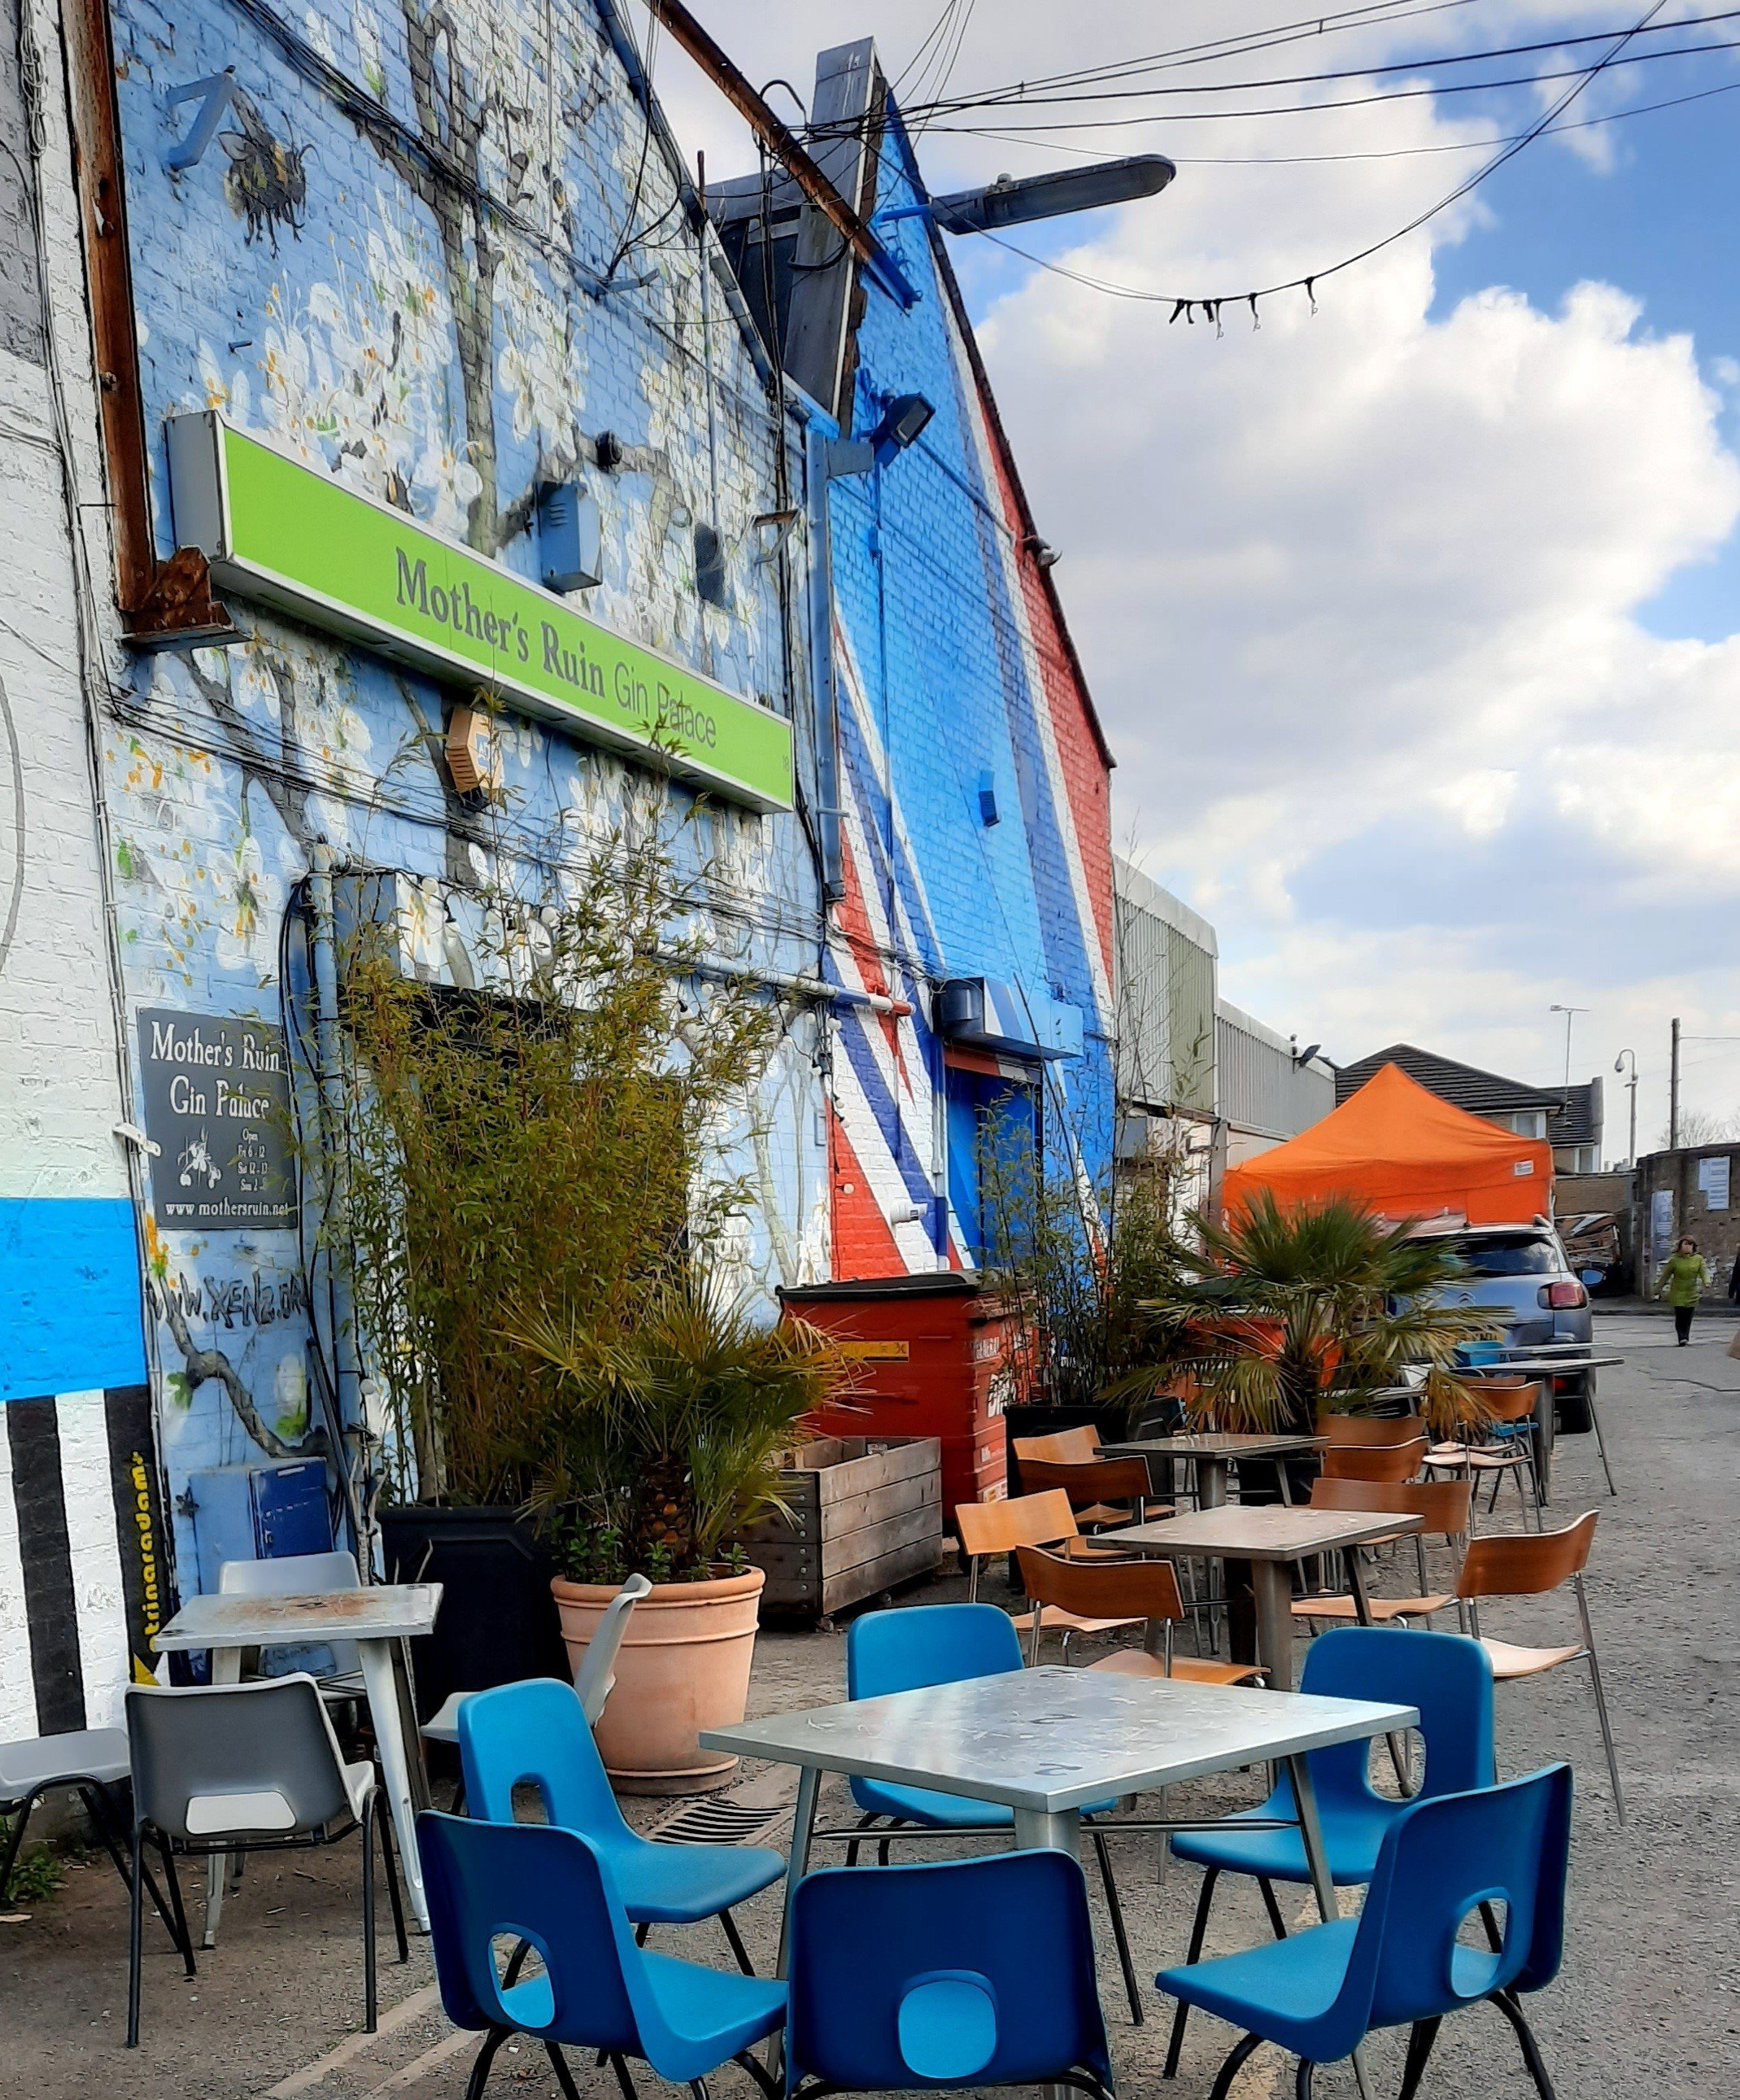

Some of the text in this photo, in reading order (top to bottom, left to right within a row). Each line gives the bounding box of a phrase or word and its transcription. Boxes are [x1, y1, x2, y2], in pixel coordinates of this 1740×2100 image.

[395, 546, 716, 749] Mother's Ruin Gin Palace
[150, 1021, 280, 1072] Mother's Ruin
[169, 1075, 269, 1120] Gin Palace
